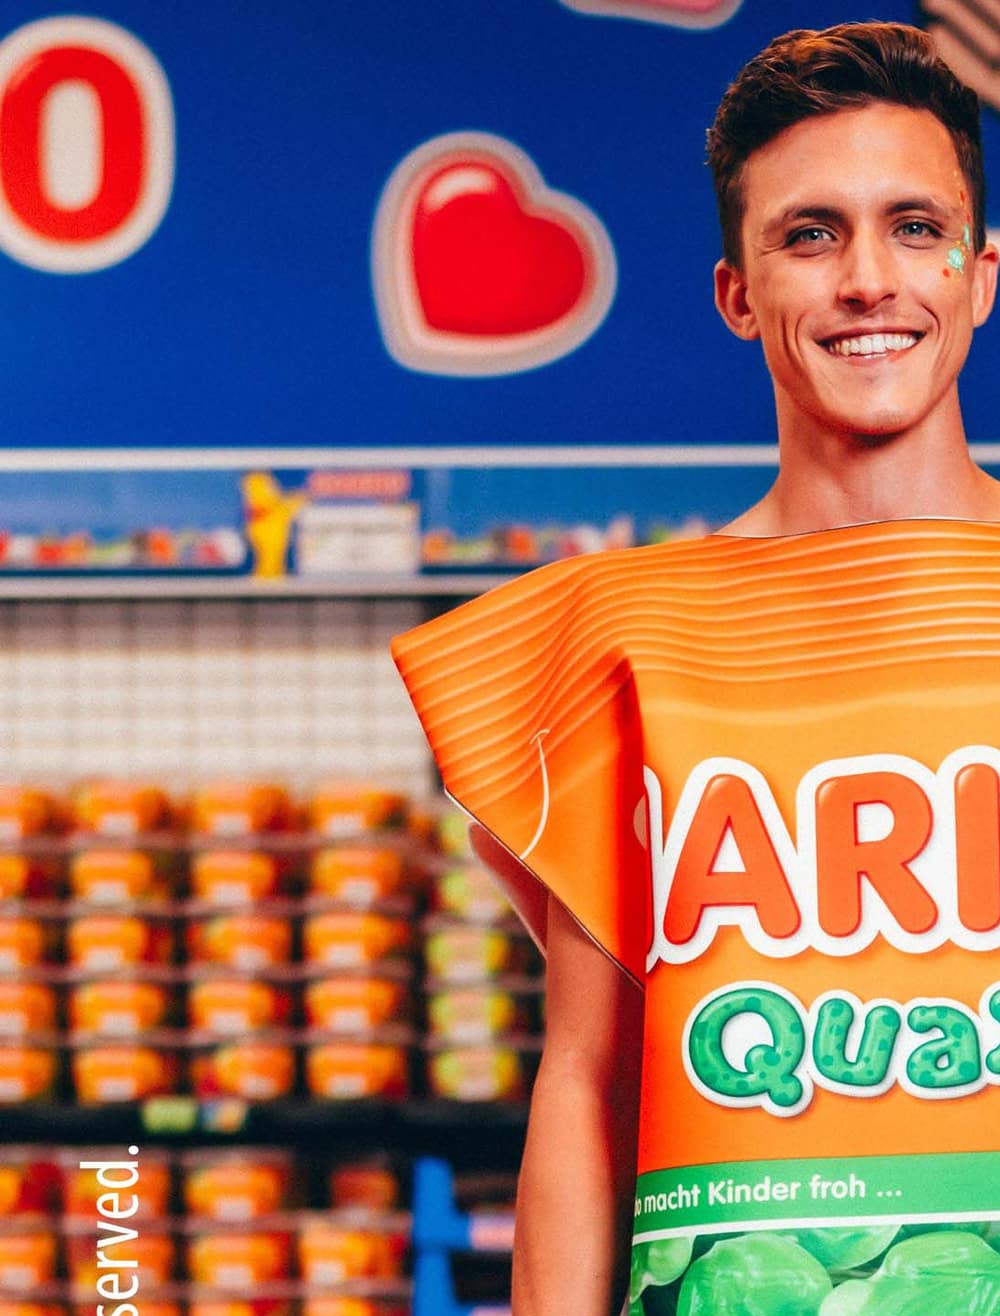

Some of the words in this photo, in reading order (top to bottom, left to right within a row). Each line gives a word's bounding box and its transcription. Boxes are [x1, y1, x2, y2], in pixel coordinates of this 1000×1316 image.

[644, 1183, 701, 1214] macht
[708, 1176, 801, 1206] Kinder
[809, 1173, 866, 1200] froh
